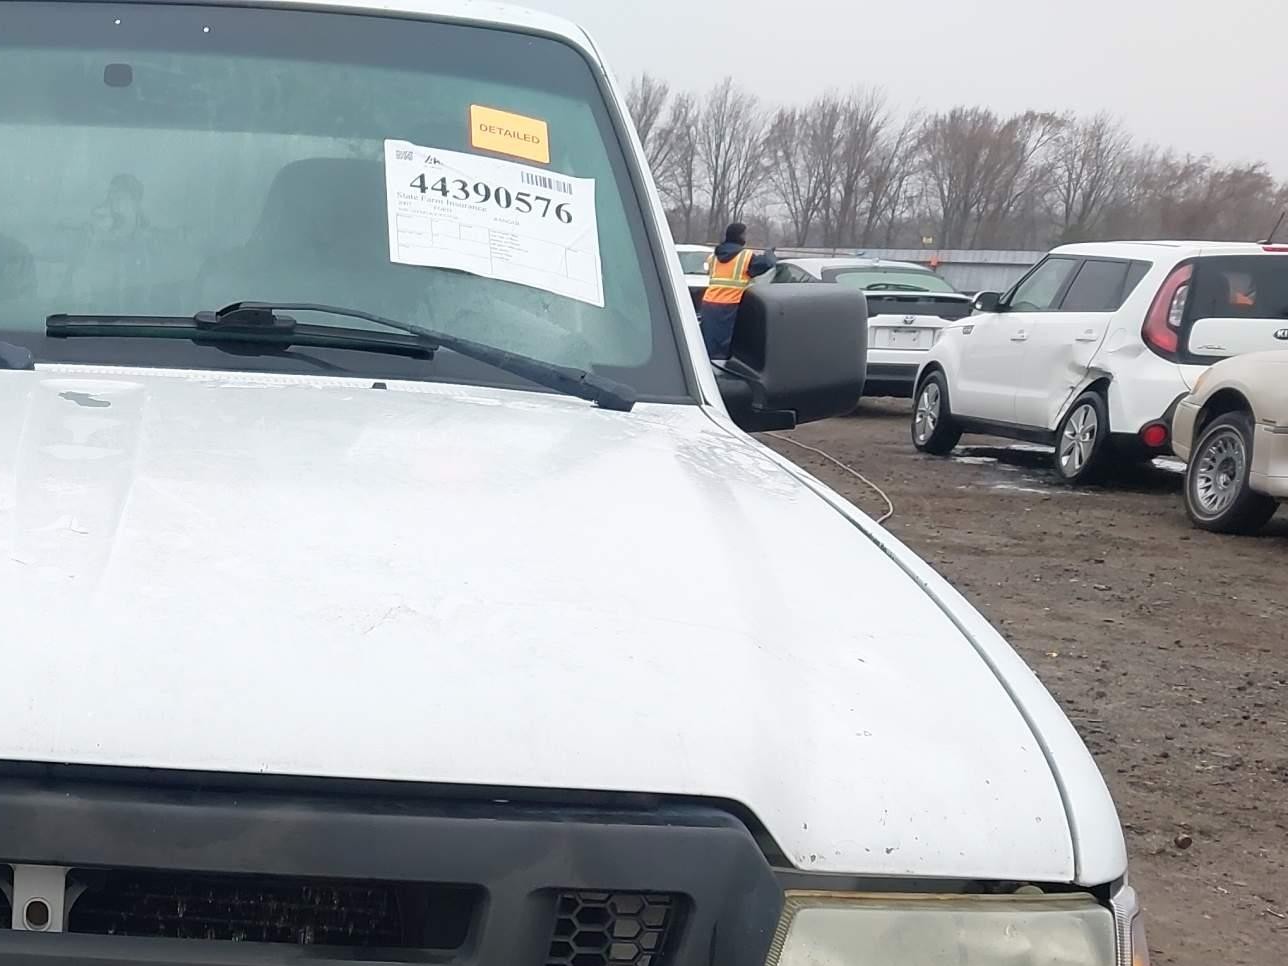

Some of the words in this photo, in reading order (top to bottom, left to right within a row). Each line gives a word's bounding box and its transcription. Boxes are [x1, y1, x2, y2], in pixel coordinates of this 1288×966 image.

[479, 123, 541, 144] DETAILED
[396, 191, 420, 201] State
[421, 194, 444, 205] Farm
[446, 197, 487, 212] Insurance
[409, 172, 573, 224] 44390576
[1276, 329, 1288, 338] KI
